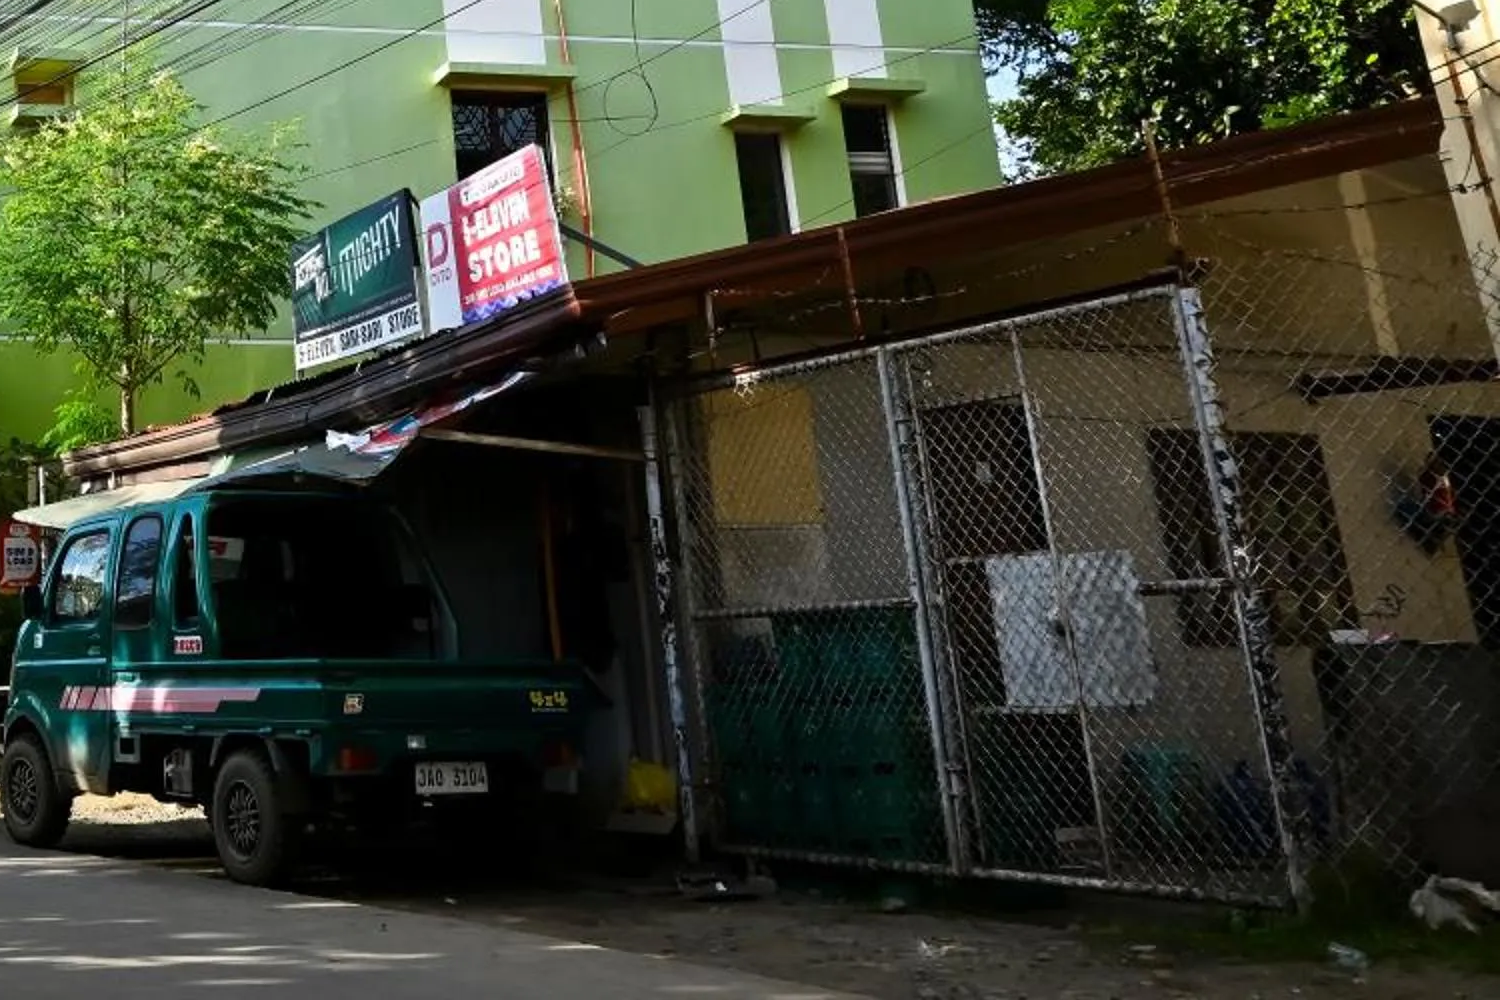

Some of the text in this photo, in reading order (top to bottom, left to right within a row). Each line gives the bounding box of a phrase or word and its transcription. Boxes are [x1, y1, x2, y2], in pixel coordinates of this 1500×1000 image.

[339, 204, 401, 296] MIGHTY
[468, 229, 541, 283] STORE
[387, 305, 419, 334] STORE
